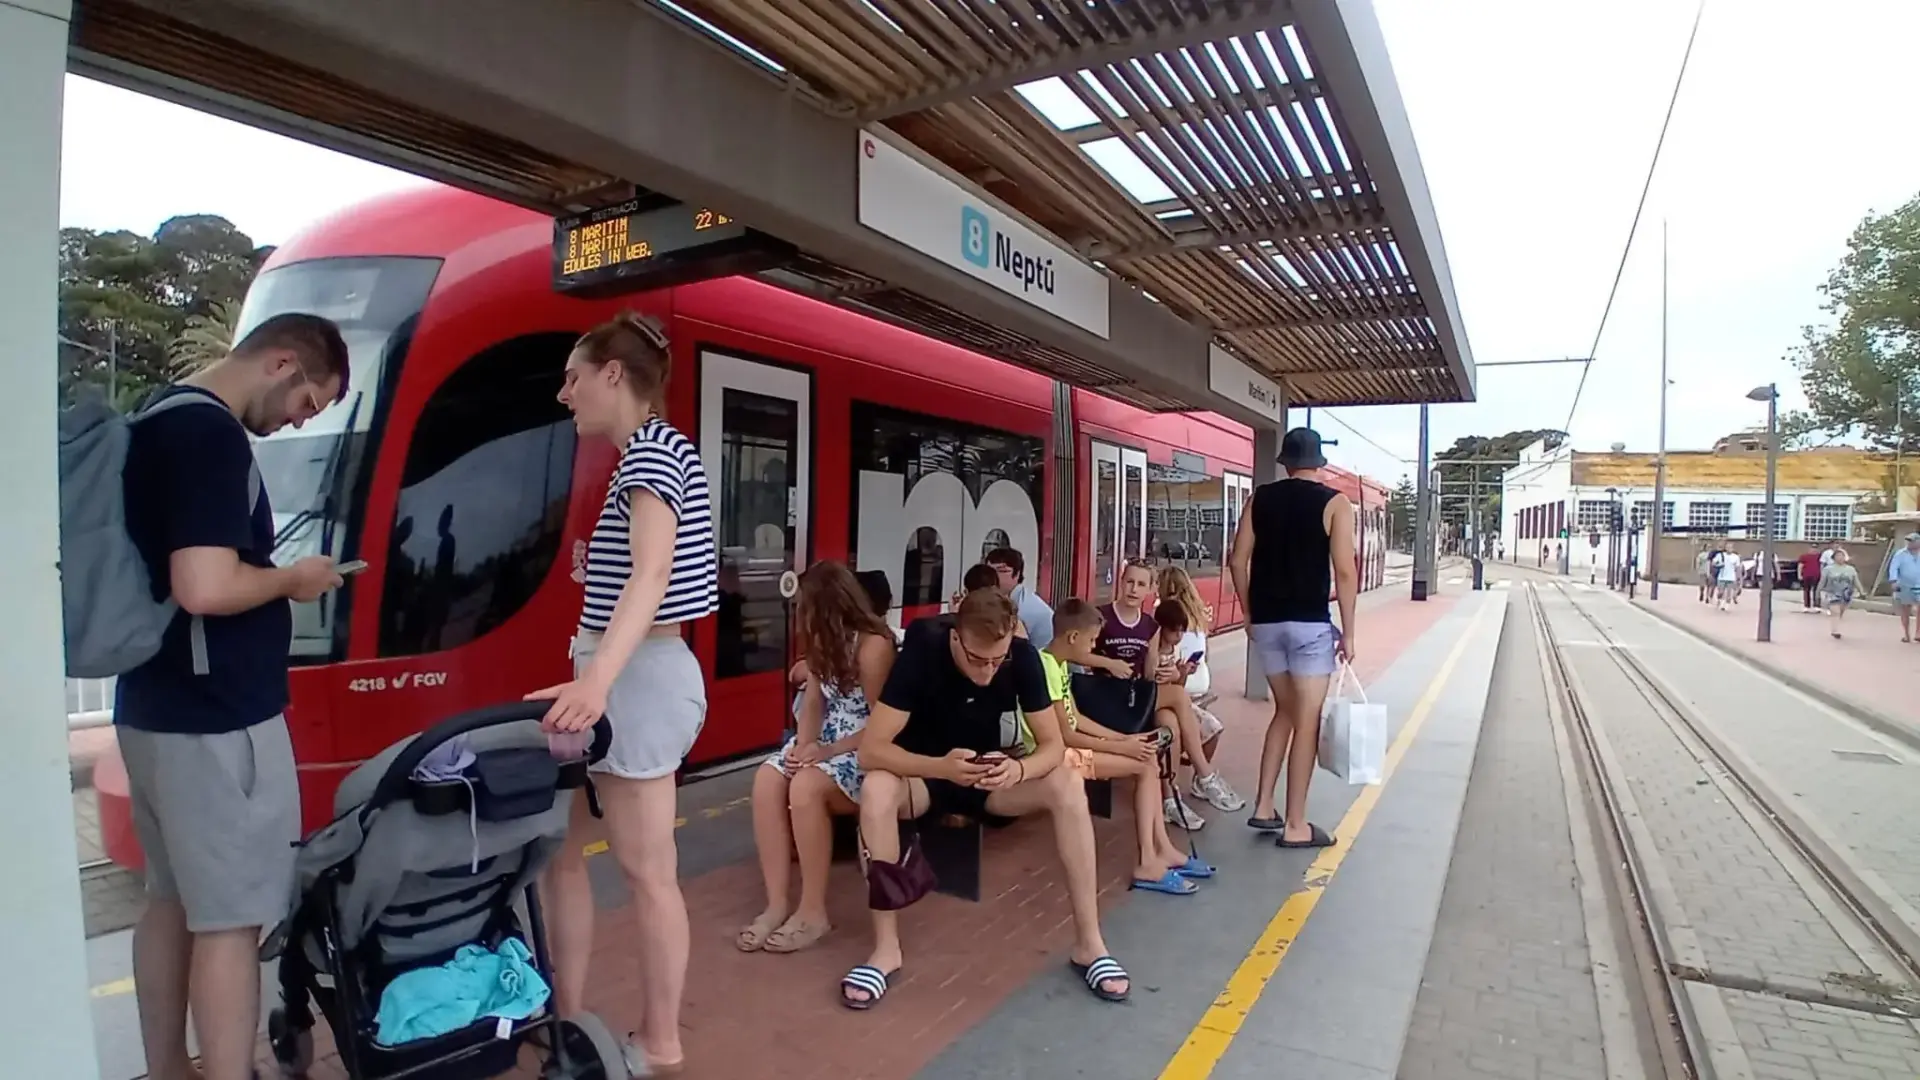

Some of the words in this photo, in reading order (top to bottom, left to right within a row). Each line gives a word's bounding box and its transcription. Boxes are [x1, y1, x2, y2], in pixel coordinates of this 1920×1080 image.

[569, 229, 578, 245] 8
[581, 215, 629, 242] MARITIM
[569, 244, 577, 259] 8
[581, 231, 628, 257] MARITIM
[694, 211, 713, 230] 22
[562, 253, 602, 276] EDULES
[607, 248, 621, 265] IN
[968, 217, 983, 257] 8
[995, 231, 1055, 296] Neptú
[1105, 637, 1127, 645] SANTA
[1127, 637, 1149, 647] MONIC
[348, 676, 387, 692] 4218
[412, 671, 447, 688] FGV
